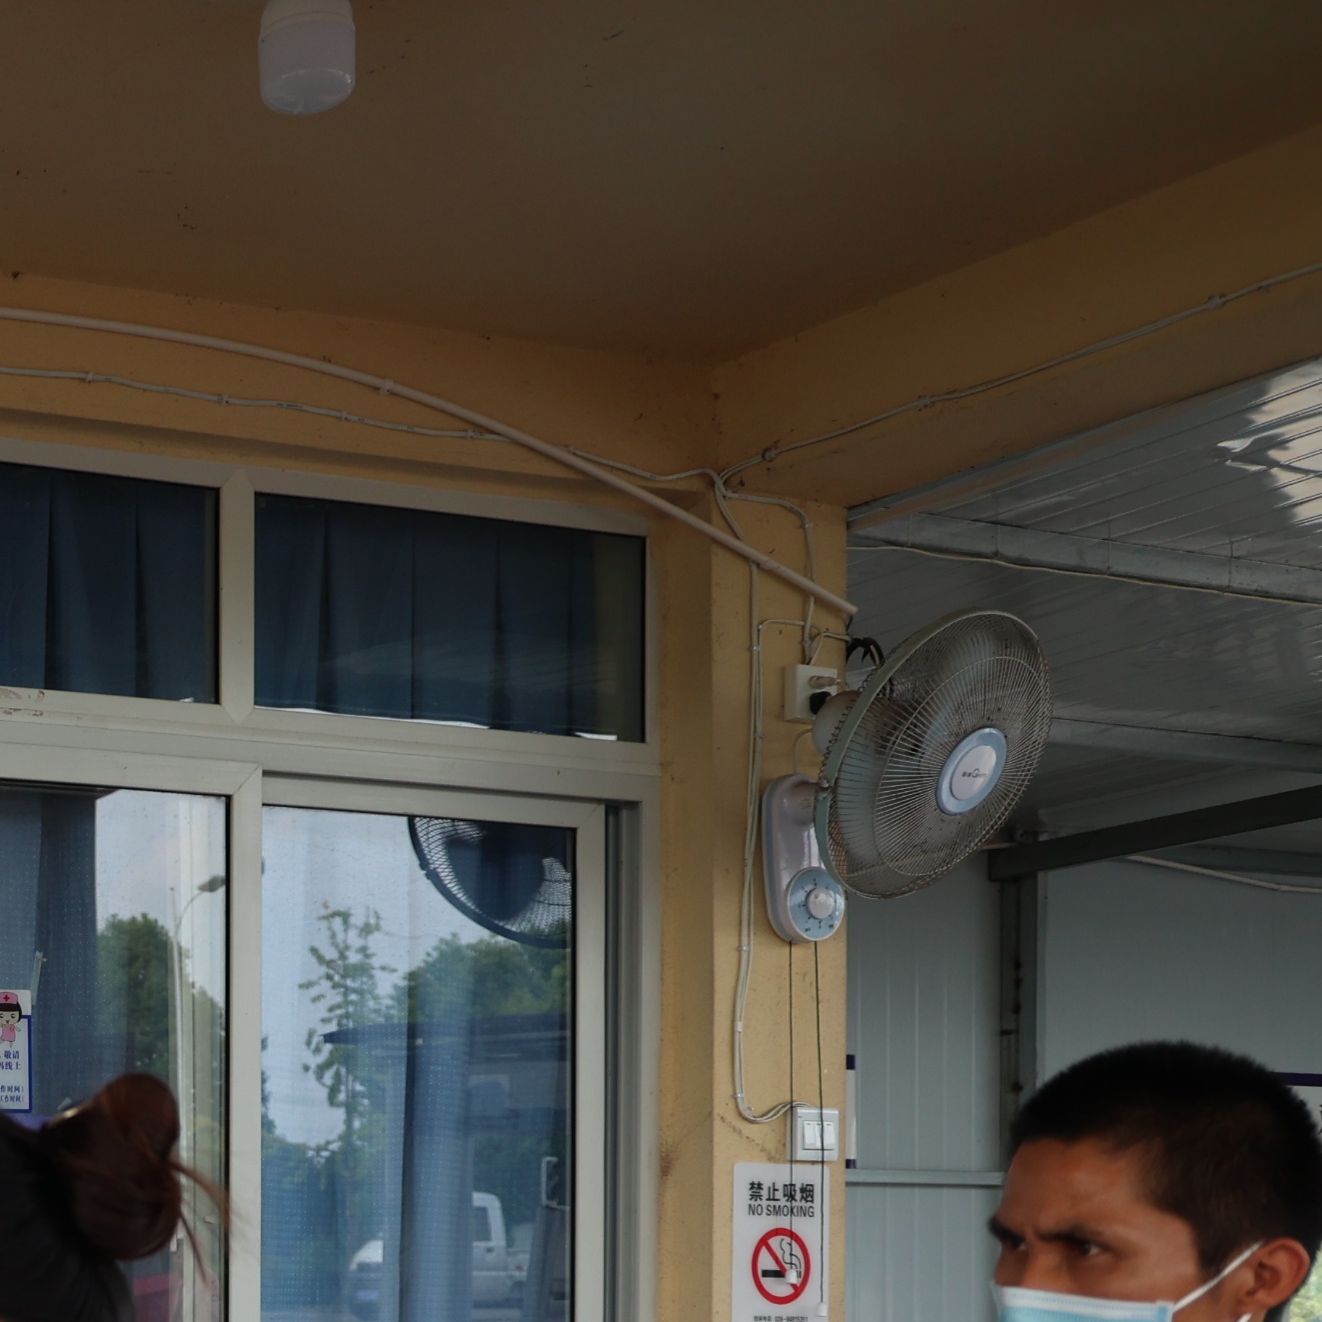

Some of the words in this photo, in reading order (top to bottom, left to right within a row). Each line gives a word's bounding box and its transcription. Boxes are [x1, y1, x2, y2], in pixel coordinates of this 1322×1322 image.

[749, 1181, 814, 1204] 禁止吸烟
[748, 1204, 763, 1216] NO
[765, 1205, 814, 1217] SMOKING
